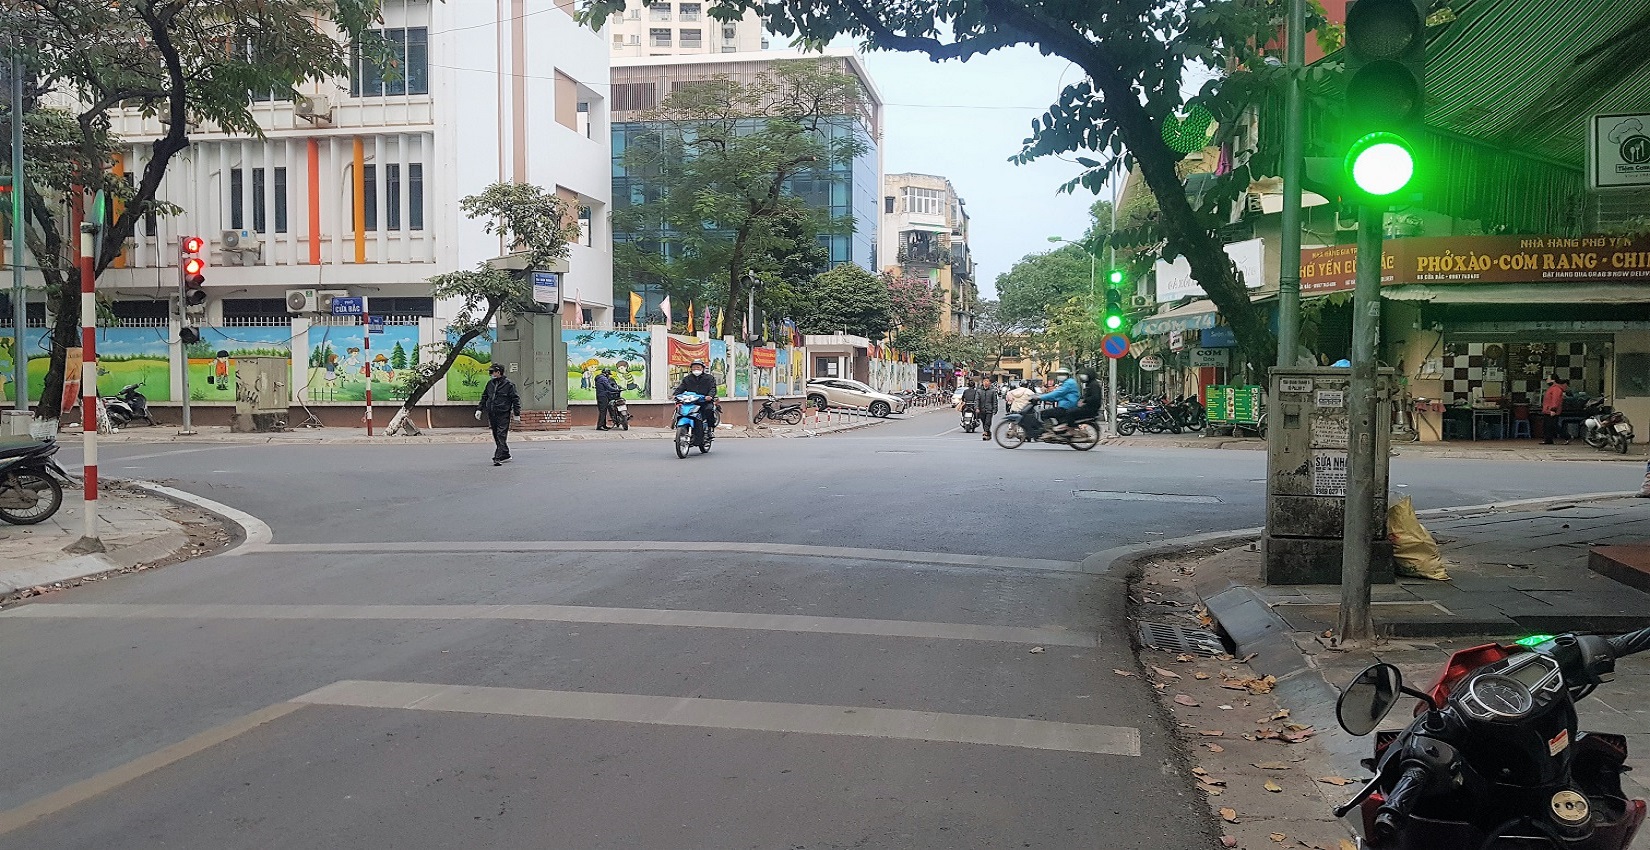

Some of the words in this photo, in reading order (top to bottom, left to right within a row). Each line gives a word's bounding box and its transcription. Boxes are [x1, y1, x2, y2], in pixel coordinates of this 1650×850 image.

[1381, 251, 1395, 270] ẮC
[1542, 252, 1598, 270] RANG
[1611, 251, 1650, 268] CHI
[335, 303, 347, 313] CỬA
[347, 303, 360, 313] BẮC
[1315, 453, 1332, 467] SỬA
